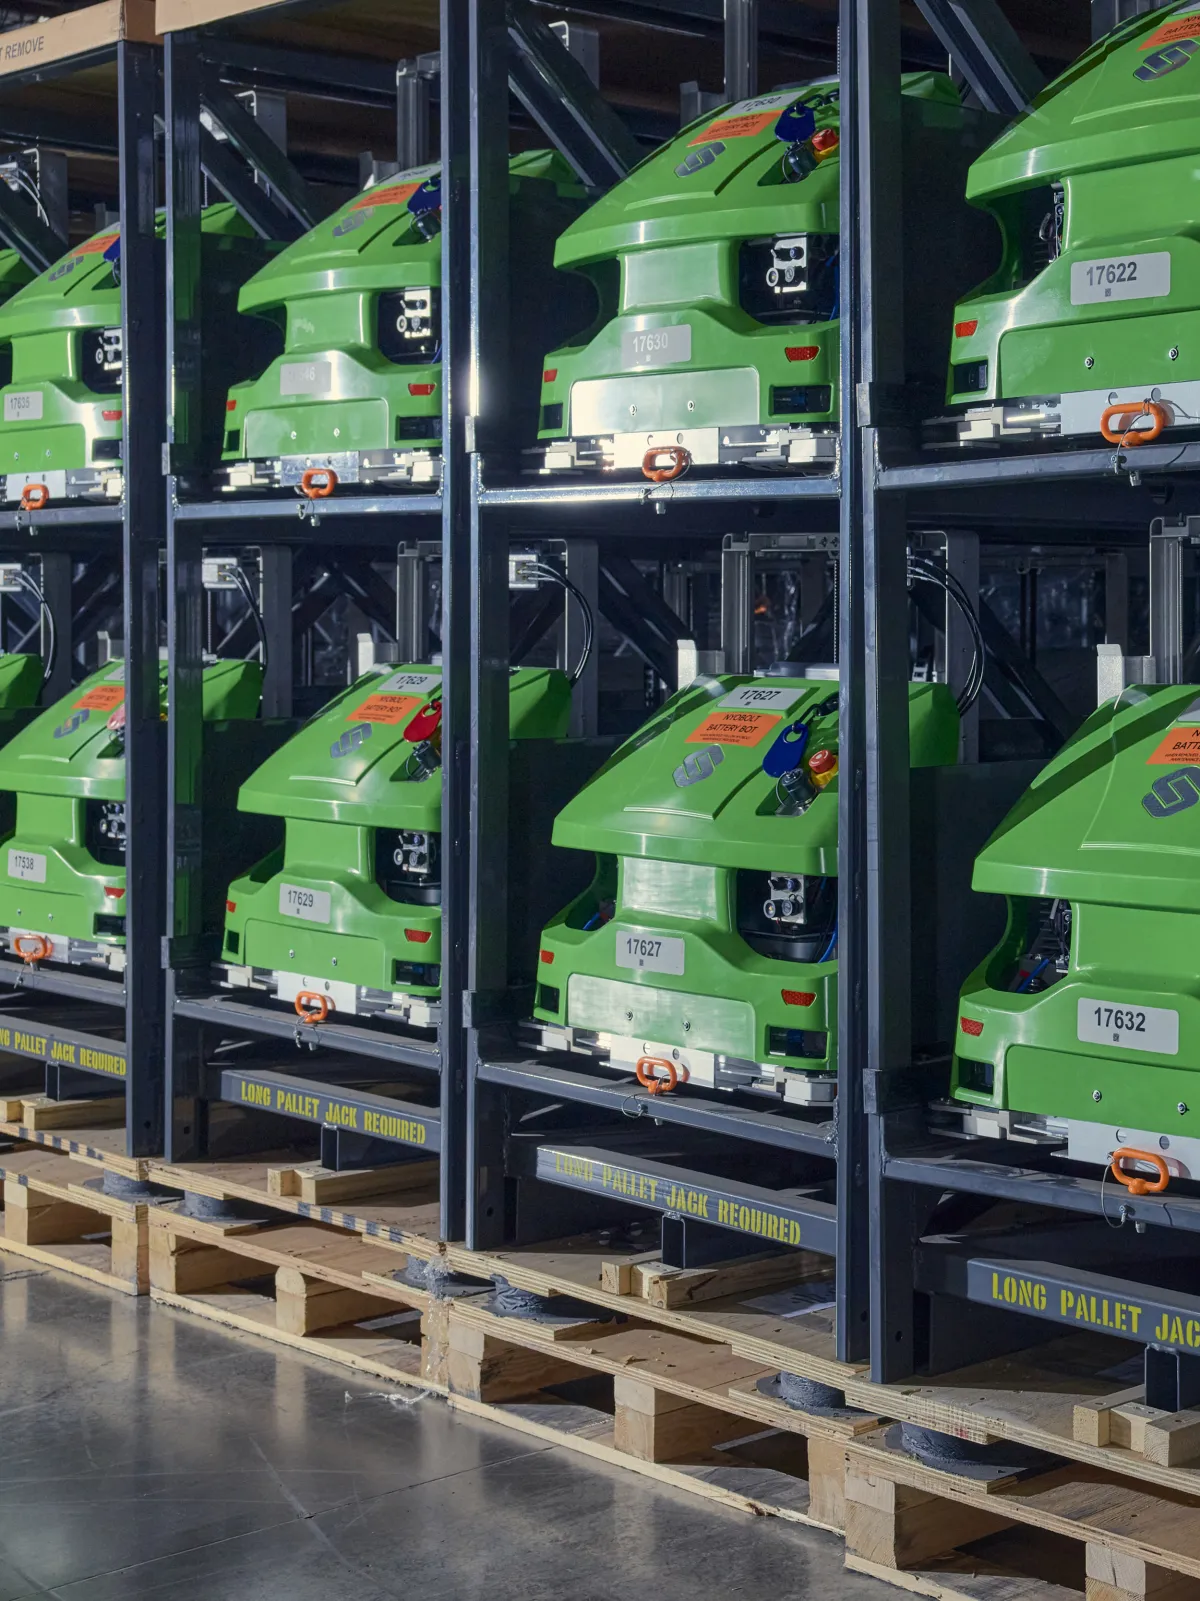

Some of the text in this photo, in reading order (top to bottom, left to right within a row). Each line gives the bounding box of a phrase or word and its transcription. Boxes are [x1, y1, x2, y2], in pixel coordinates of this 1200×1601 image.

[5, 36, 44, 60] REMOVE
[1086, 261, 1137, 286] 17622
[633, 332, 668, 353] 17630
[739, 690, 781, 701] 17627
[706, 724, 759, 733] BATTERY BOT
[723, 714, 762, 722] NYOBOLT
[288, 889, 314, 907] 17629
[627, 938, 662, 957] 17627
[1094, 1007, 1146, 1032] 17632
[14, 1031, 47, 1056] PALLET
[51, 1041, 75, 1063] JACK
[80, 1048, 126, 1076] REQUIRED
[241, 1081, 425, 1144] LONG PALLET JACK REQUIRED
[555, 1151, 801, 1245] LONG PALLET JACK REQUIRED
[992, 1272, 1046, 1311] LONG
[1060, 1289, 1141, 1334] PALLET
